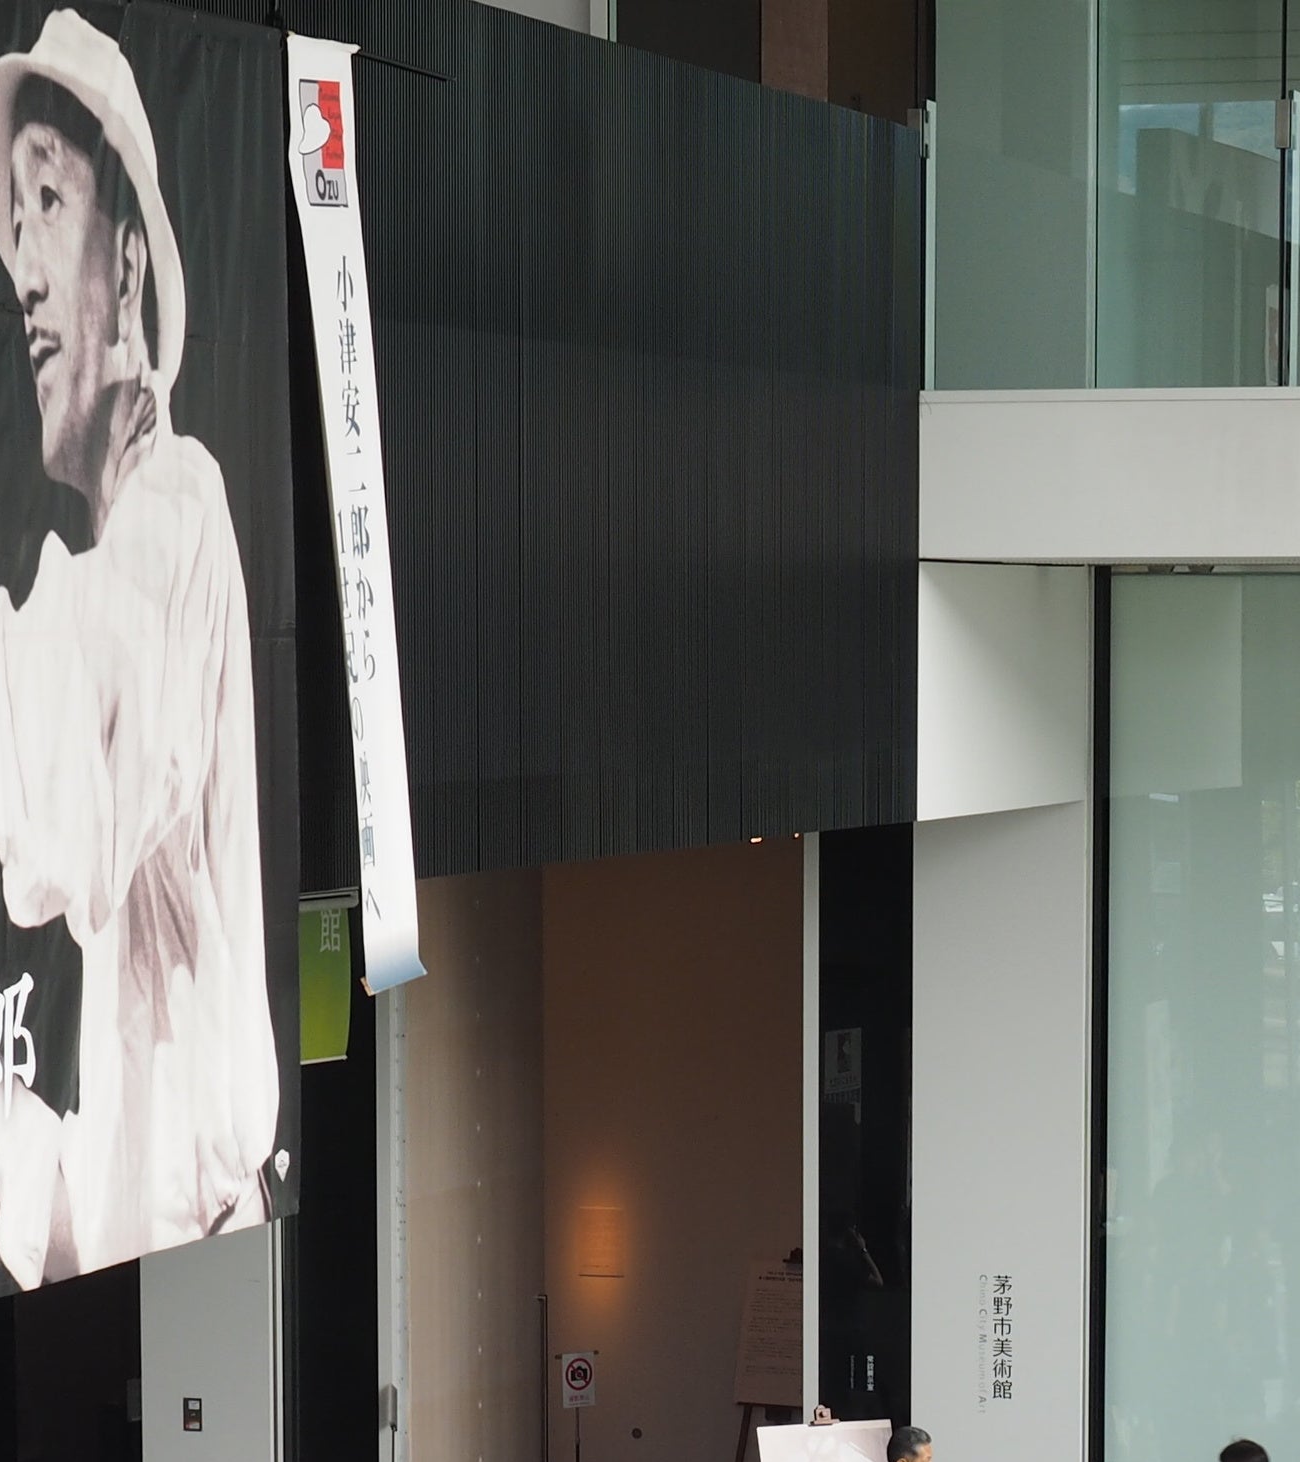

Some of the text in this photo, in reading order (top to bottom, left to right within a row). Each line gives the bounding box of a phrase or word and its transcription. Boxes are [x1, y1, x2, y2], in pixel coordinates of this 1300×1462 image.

[337, 256, 376, 681] 小津安二郎から
[993, 1275, 1012, 1400] 茅野市美術館
